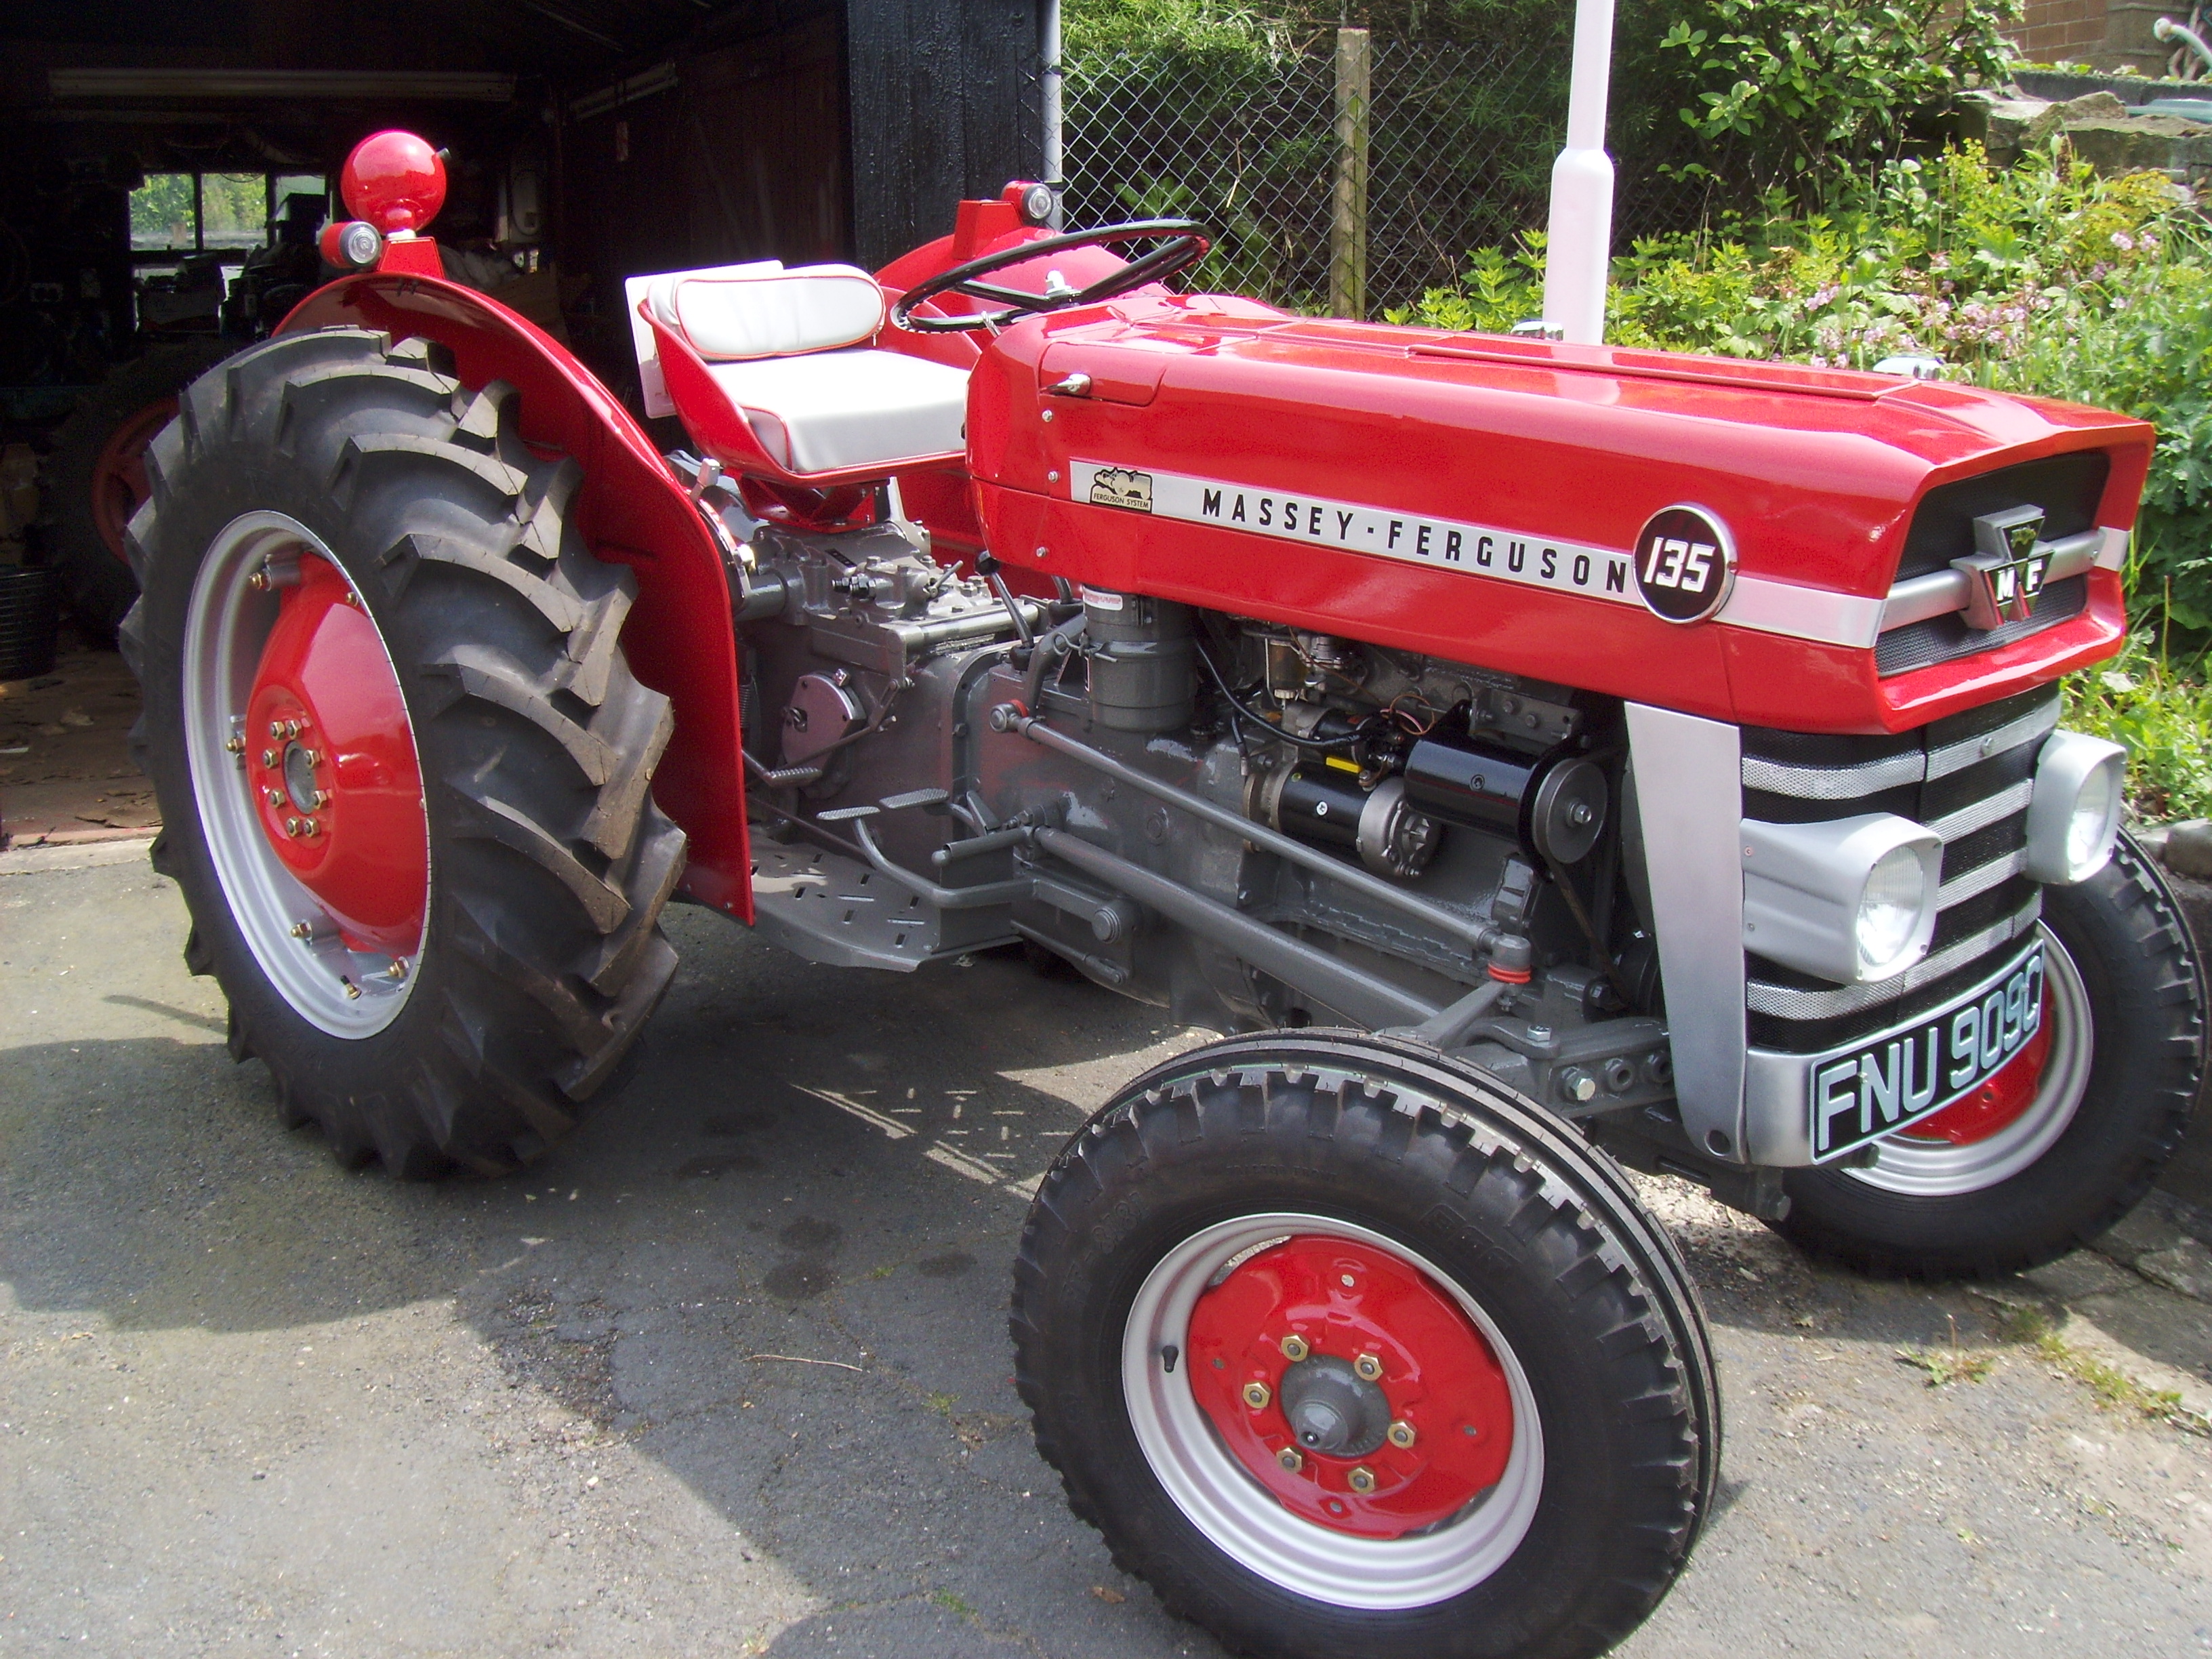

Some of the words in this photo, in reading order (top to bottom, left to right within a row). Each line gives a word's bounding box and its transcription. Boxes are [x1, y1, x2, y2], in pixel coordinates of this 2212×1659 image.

[1094, 493, 1124, 504] FERGUSON
[1126, 498, 1149, 508] SYSTEM
[1643, 536, 1716, 593] 135
[1818, 1026, 1938, 1151] FNU
[1950, 956, 2041, 1089] 909C
